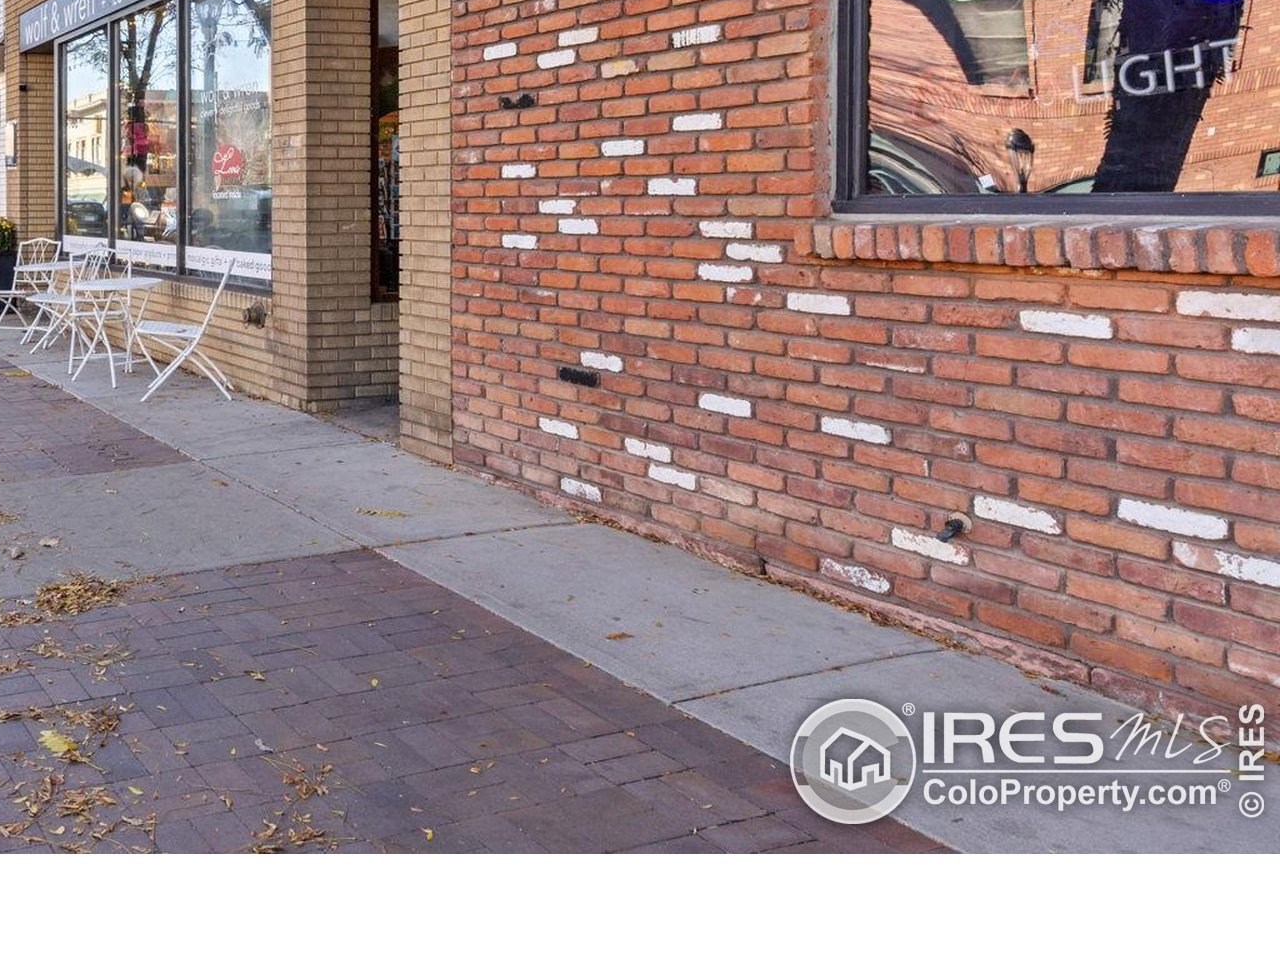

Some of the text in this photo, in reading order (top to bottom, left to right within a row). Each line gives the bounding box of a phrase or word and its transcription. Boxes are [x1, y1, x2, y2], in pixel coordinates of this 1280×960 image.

[24, 13, 48, 45] wolf
[51, 1, 60, 34] &
[1072, 37, 1241, 102] LIGHT
